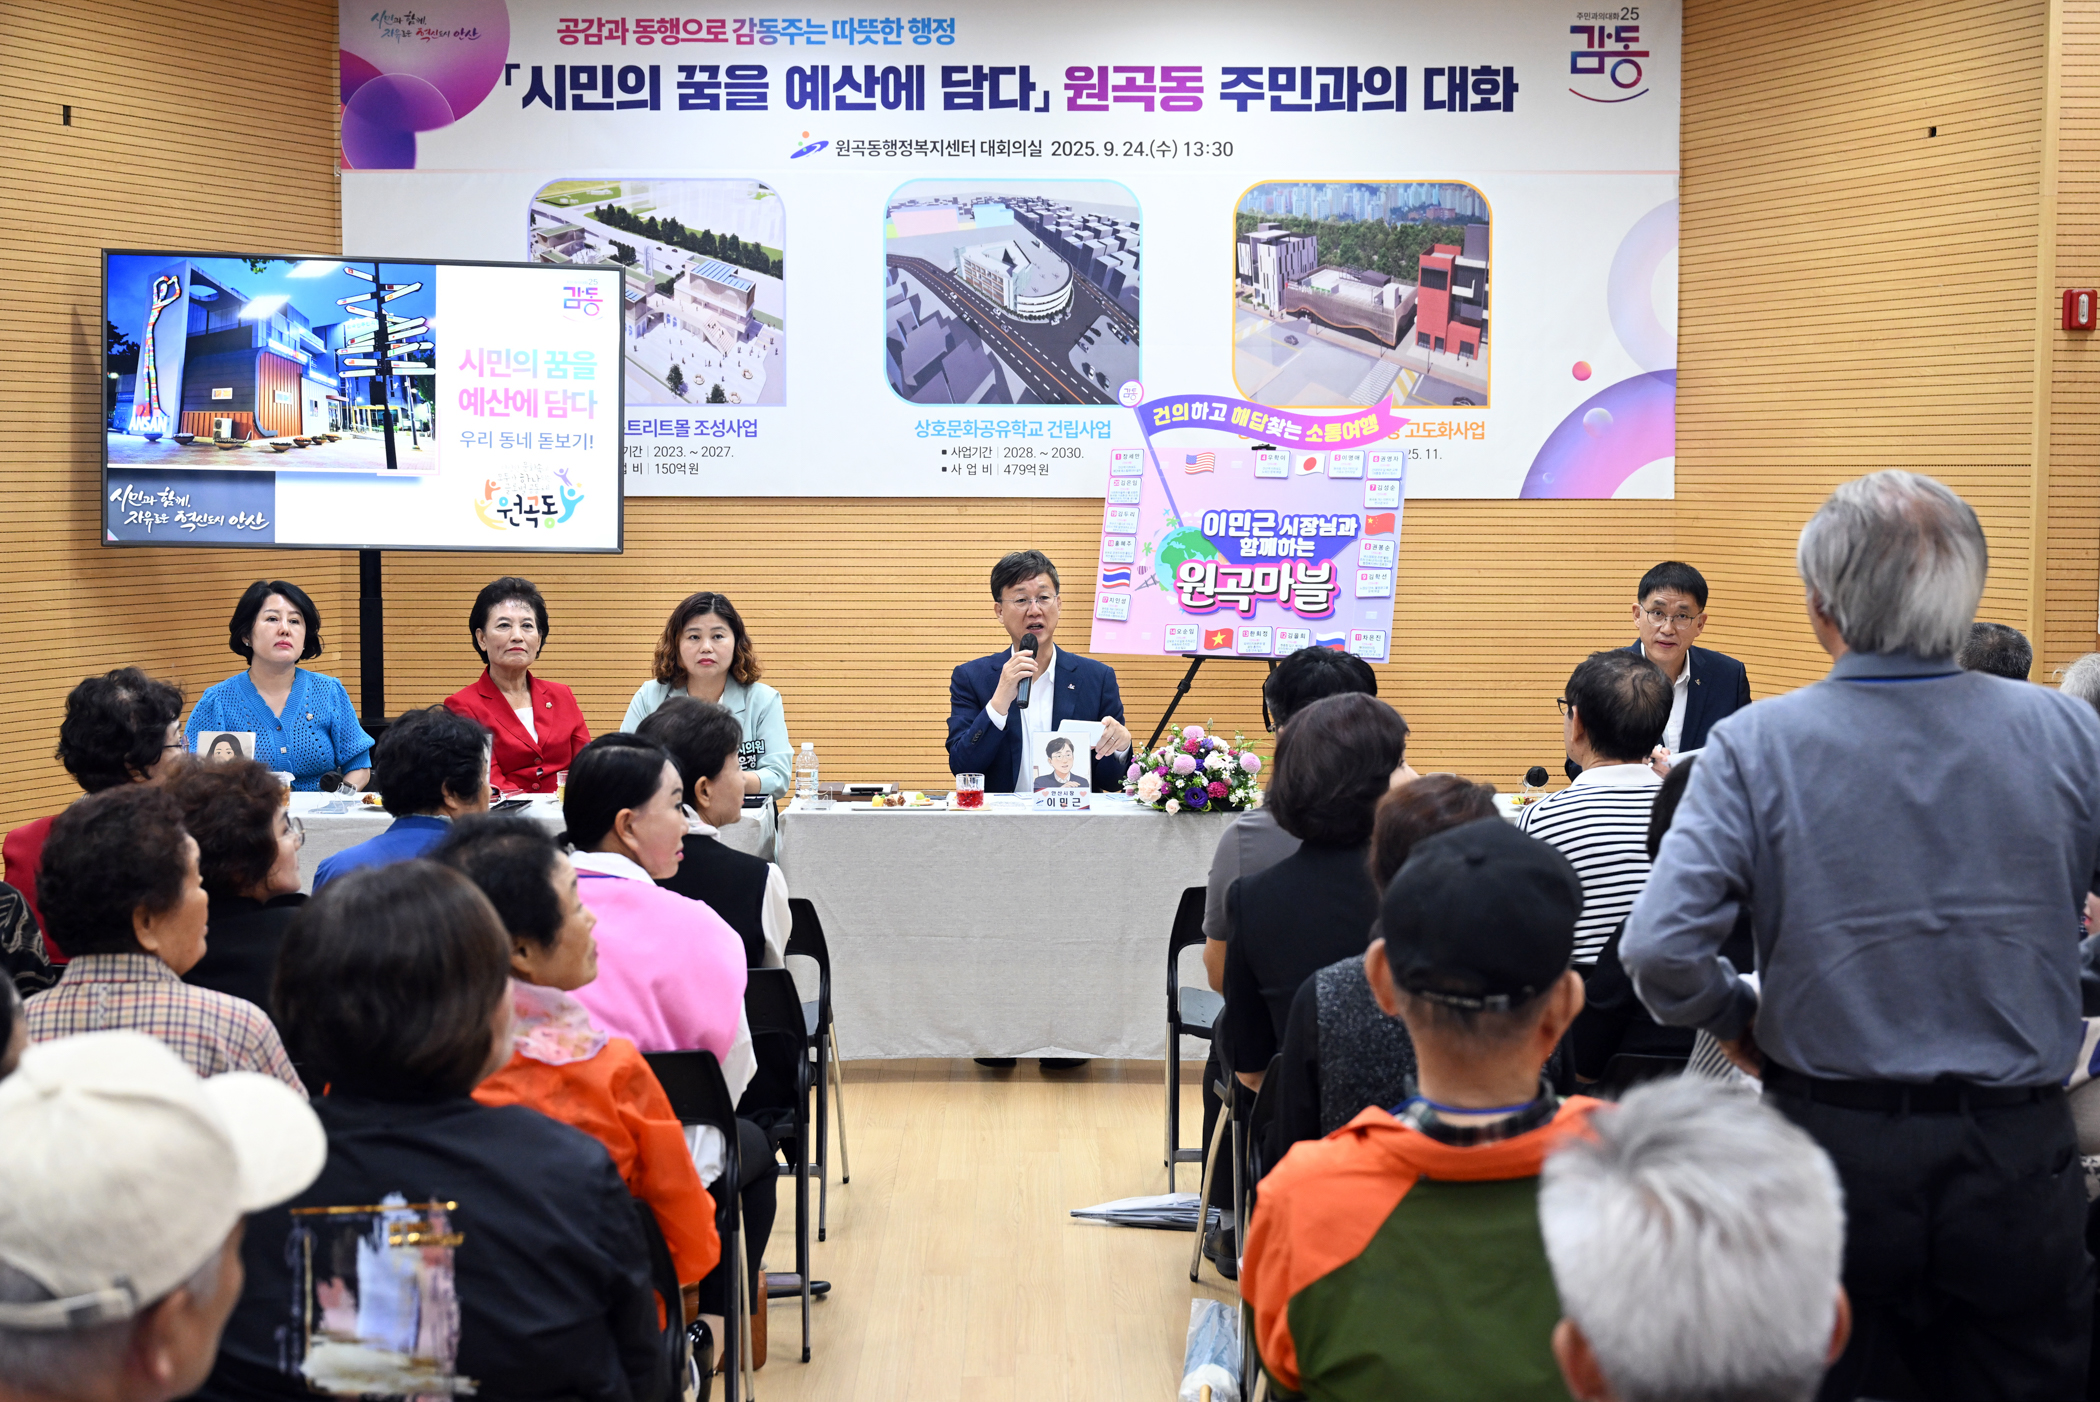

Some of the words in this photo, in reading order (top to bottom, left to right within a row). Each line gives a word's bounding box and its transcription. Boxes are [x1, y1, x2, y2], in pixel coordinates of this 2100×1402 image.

[370, 10, 402, 29] 시민과
[558, 17, 628, 45] 공감과
[633, 17, 728, 45] 동행으로
[732, 17, 828, 45] 감동주는
[832, 17, 904, 45] 따뜻한
[908, 17, 955, 45] 행정
[380, 28, 412, 44] 자유로운
[415, 27, 451, 43] 혁신도시
[453, 27, 482, 41] 안산
[1570, 25, 1649, 89] 감동
[676, 64, 769, 111] 꿈을
[786, 65, 924, 111] 예산에
[1064, 66, 1204, 112] 원곡동
[1220, 66, 1406, 112] 주민과의
[1424, 66, 1518, 112] 대화
[836, 139, 976, 158] 원곡동행정복지센터
[980, 139, 1042, 158] 대회의실
[1051, 141, 1099, 157] 2025.
[1104, 141, 1118, 157] 9.
[1184, 141, 1233, 157] 13:30
[563, 286, 603, 316] 감동
[458, 348, 538, 378] 시민의
[544, 350, 598, 380] 꿈을
[458, 387, 538, 418] 예산에
[544, 389, 598, 419] 담다
[128, 414, 168, 432] ANSAN
[624, 419, 690, 438] 트리트몰
[694, 419, 757, 438] 조성사업
[914, 420, 1044, 439] 상호문화공유학교
[1048, 420, 1111, 439] 건립사업
[1153, 402, 1227, 426] 건의하고
[1231, 406, 1302, 440] 해답찾는
[1305, 414, 1380, 442] 소통여행
[1405, 420, 1484, 440] 고도화사업
[460, 431, 492, 448] 우리
[499, 432, 532, 449] 동네
[538, 433, 594, 450] 돋보기!
[654, 446, 686, 458] 2023.
[701, 446, 734, 458] 2027.
[951, 446, 992, 458] 사업기간
[1004, 446, 1036, 458] 2028.
[1052, 446, 1084, 458] 2030.
[110, 484, 157, 512] 시민과
[124, 510, 170, 533] 자유로운
[174, 510, 225, 533] 혁신도시
[229, 511, 270, 530] 안산
[497, 494, 558, 529] 원곡동
[1203, 512, 1276, 537] 이민근
[1280, 517, 1358, 537] 시장님과
[1240, 538, 1316, 557] 함께하는
[1176, 562, 1334, 612] 원곡마블
